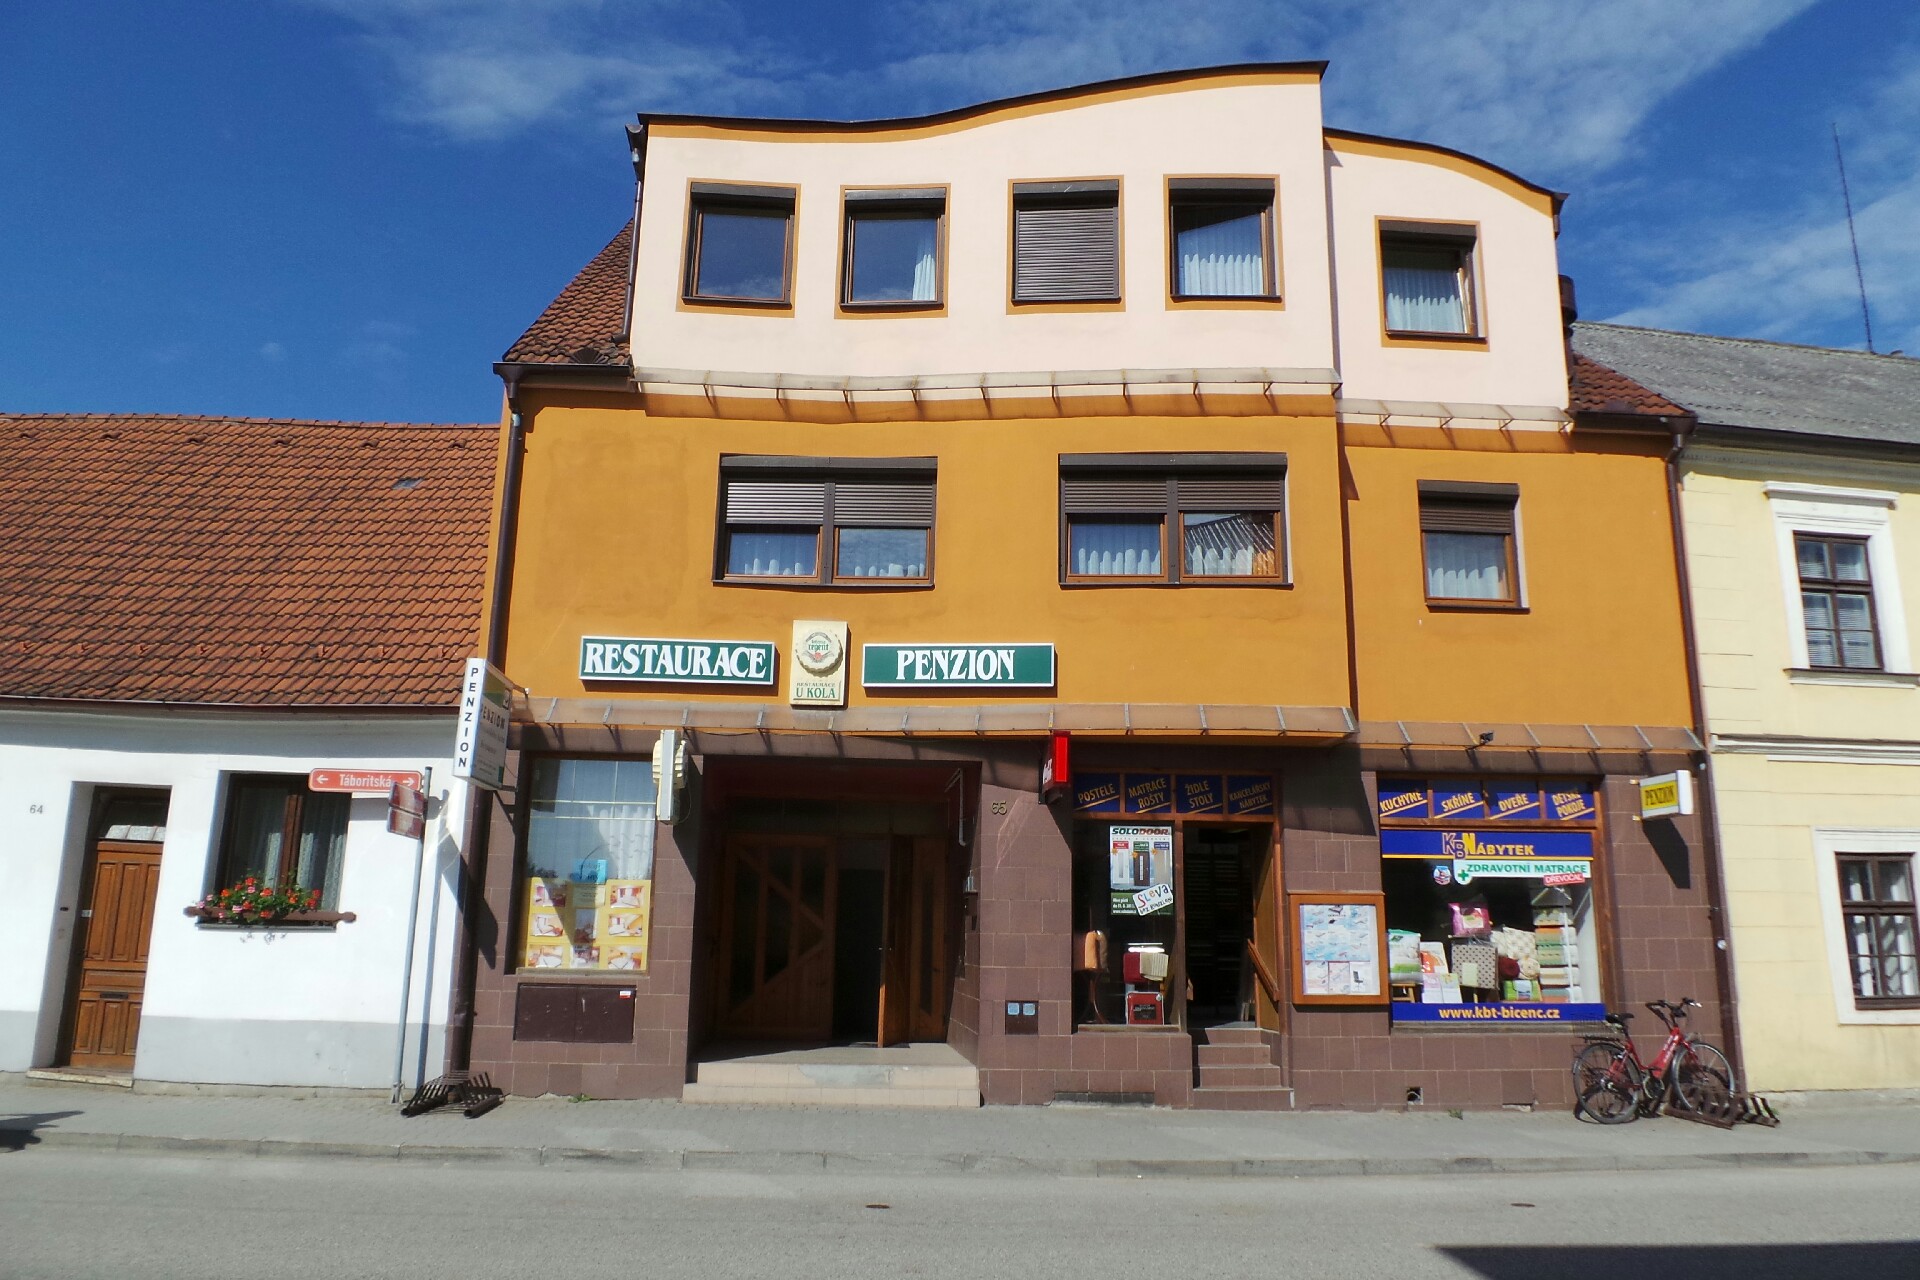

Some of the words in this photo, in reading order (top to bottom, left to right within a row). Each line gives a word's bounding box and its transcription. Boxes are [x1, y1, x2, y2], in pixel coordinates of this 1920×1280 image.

[583, 643, 767, 679] RESTAURACE
[895, 649, 1016, 681] PENZION
[796, 687, 803, 698] U
[807, 687, 836, 699] KOLA
[458, 667, 479, 768] PENZION
[339, 774, 392, 788] Táboritská
[1128, 778, 1167, 798] MATRACE
[1184, 780, 1210, 796] ŽIDLE
[1077, 783, 1116, 803] POSTELE
[1189, 793, 1214, 808] STOLY
[29, 804, 44, 815] 64
[991, 801, 1007, 815] 65
[1466, 862, 1530, 873] ZDRAVOTNÍ
[1534, 864, 1587, 874] MATRACE
[1439, 1006, 1561, 1019] www.kbt-bicenc.cz
